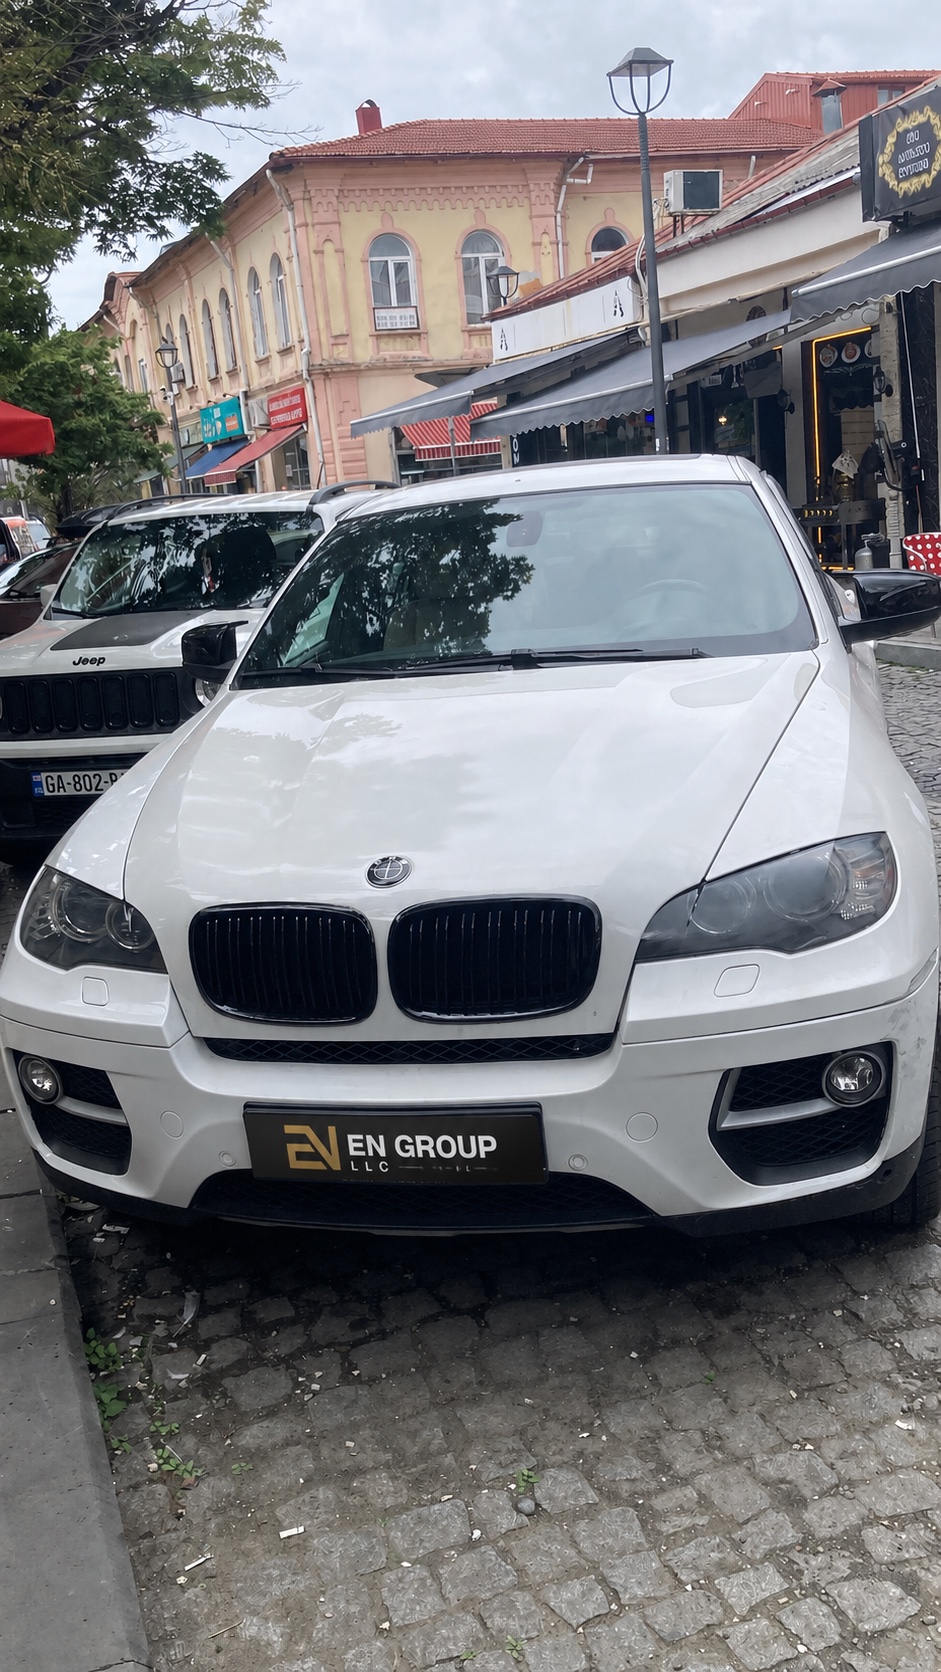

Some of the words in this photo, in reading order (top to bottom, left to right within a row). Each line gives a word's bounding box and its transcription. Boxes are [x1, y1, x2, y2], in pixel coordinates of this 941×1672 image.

[72, 656, 106, 667] Jeep
[346, 1133, 387, 1158] EN
[394, 1134, 498, 1159] GROUP
[350, 1161, 389, 1173] LLC
